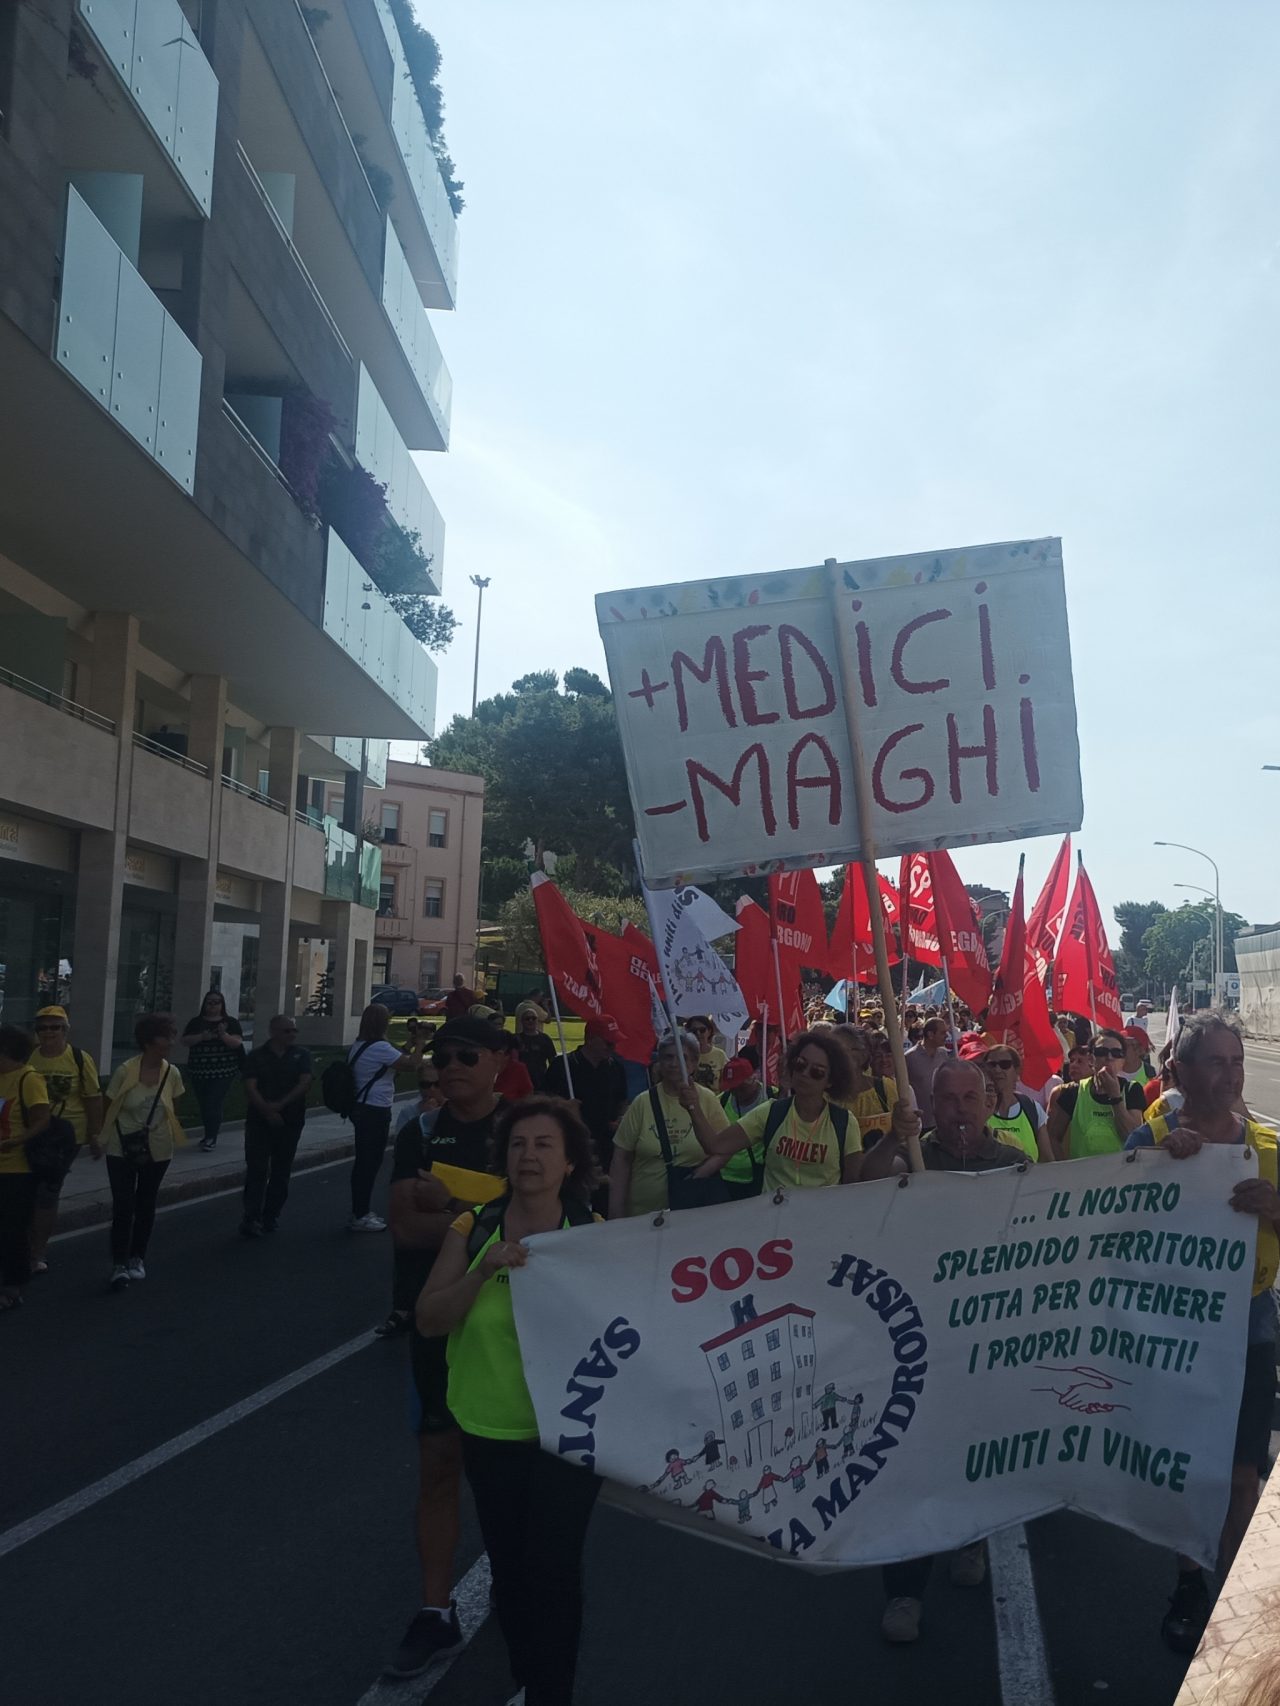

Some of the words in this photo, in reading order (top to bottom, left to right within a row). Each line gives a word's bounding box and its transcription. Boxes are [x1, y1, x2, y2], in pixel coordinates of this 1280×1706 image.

[1046, 1192, 1071, 1220] IL
[1078, 1182, 1181, 1217] NOSTRO
[670, 1238, 794, 1303] SOS
[933, 1236, 1079, 1283] SPLENDIDO
[1088, 1230, 1247, 1272] TERRITORIO
[948, 1288, 1022, 1328] LOTTA
[1031, 1279, 1081, 1315] PER
[1089, 1277, 1227, 1323] OTTENERE
[968, 1343, 980, 1374] I
[987, 1326, 1081, 1370] PROPRI
[1089, 1327, 1200, 1373] DIRITTI!
[812, 1254, 928, 1531] MANDROLISAI
[965, 1428, 1050, 1482] UNITI
[1058, 1425, 1091, 1462] SI
[1103, 1427, 1192, 1493] VINCE
